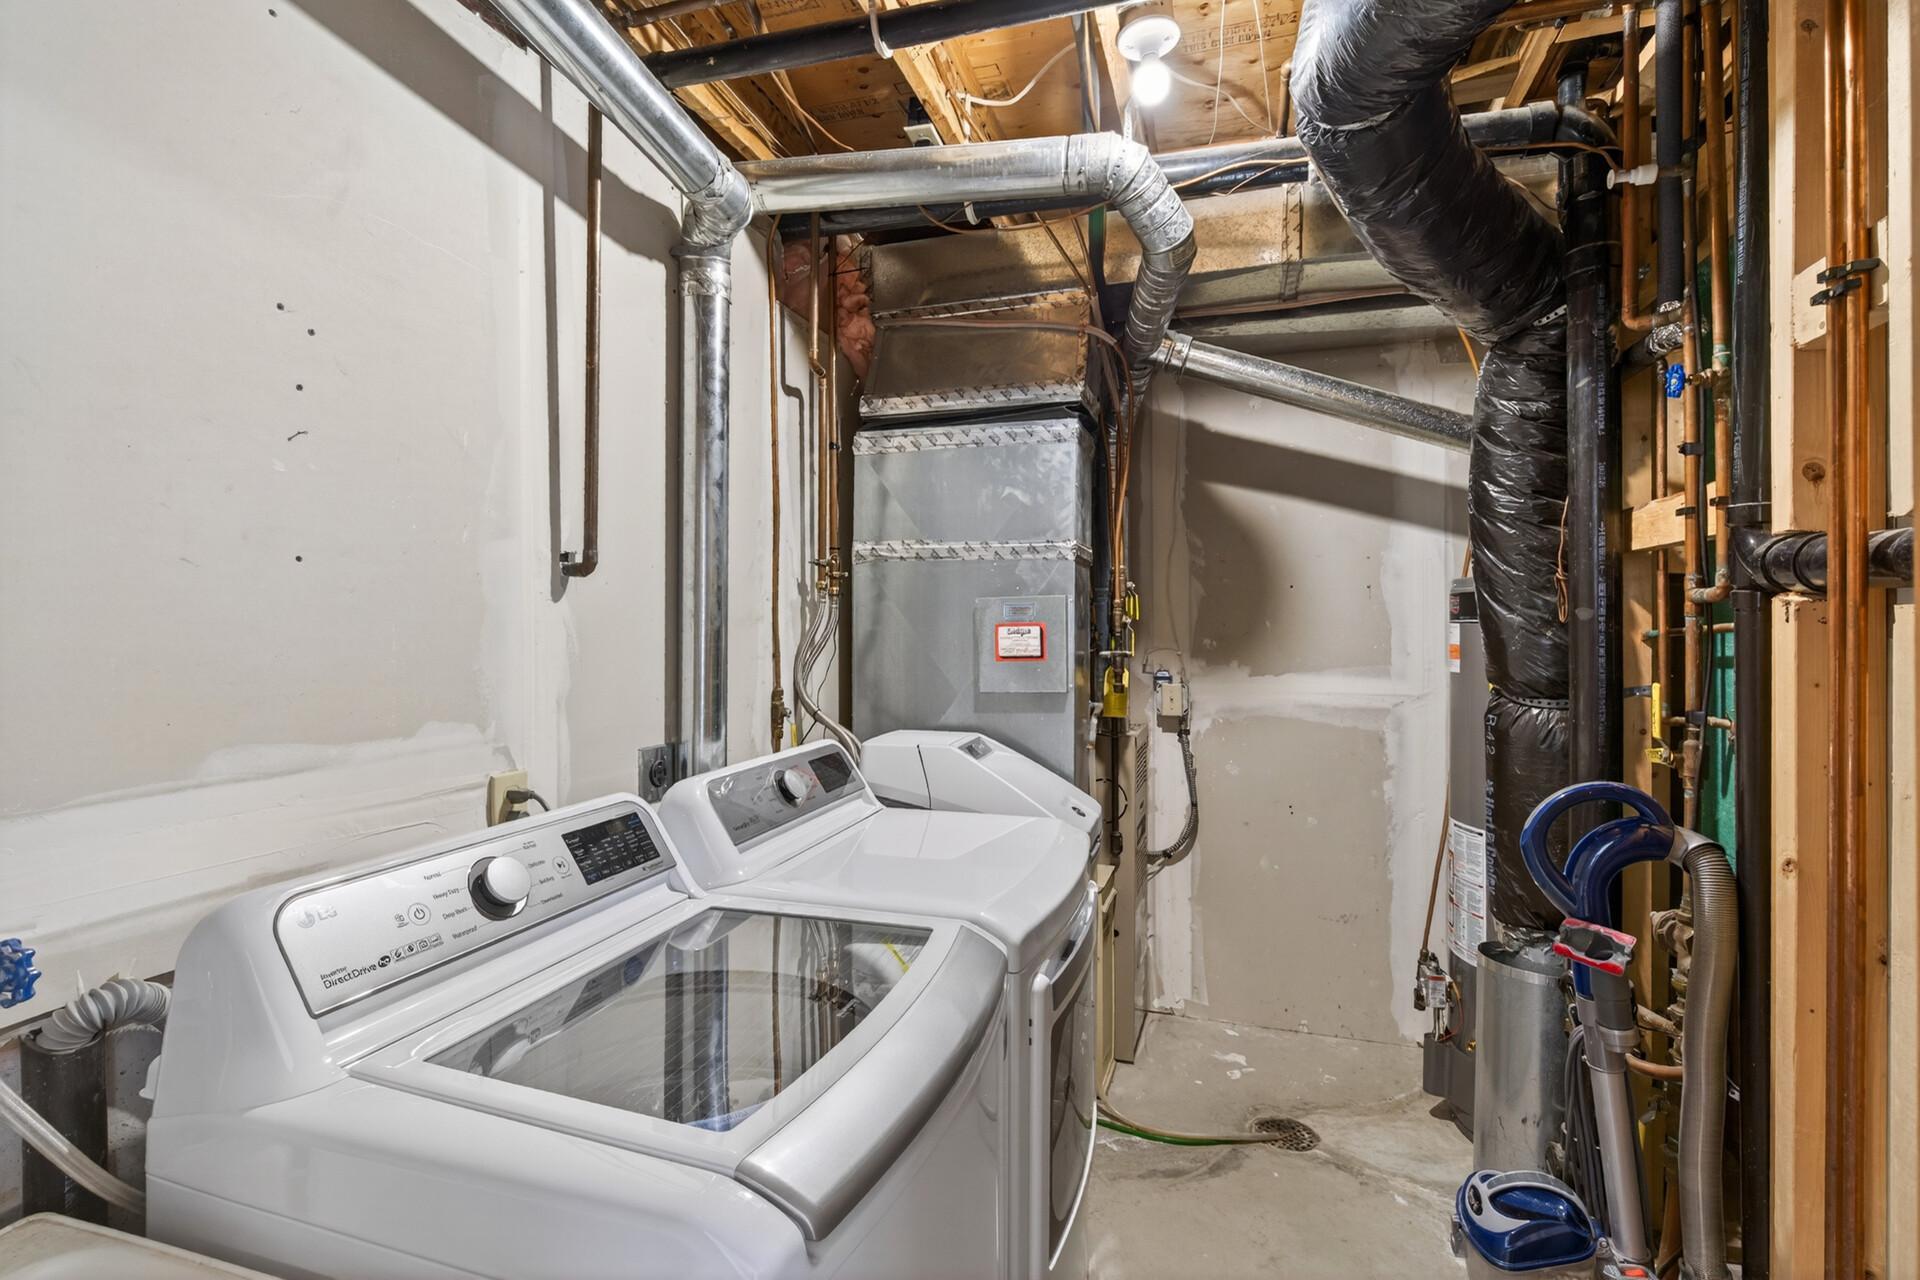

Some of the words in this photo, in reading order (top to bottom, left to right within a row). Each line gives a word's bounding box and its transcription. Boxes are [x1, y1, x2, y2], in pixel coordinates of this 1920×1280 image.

[1486, 714, 1497, 755] R-4.2
[317, 904, 338, 921] LG
[320, 966, 348, 980] Inverter
